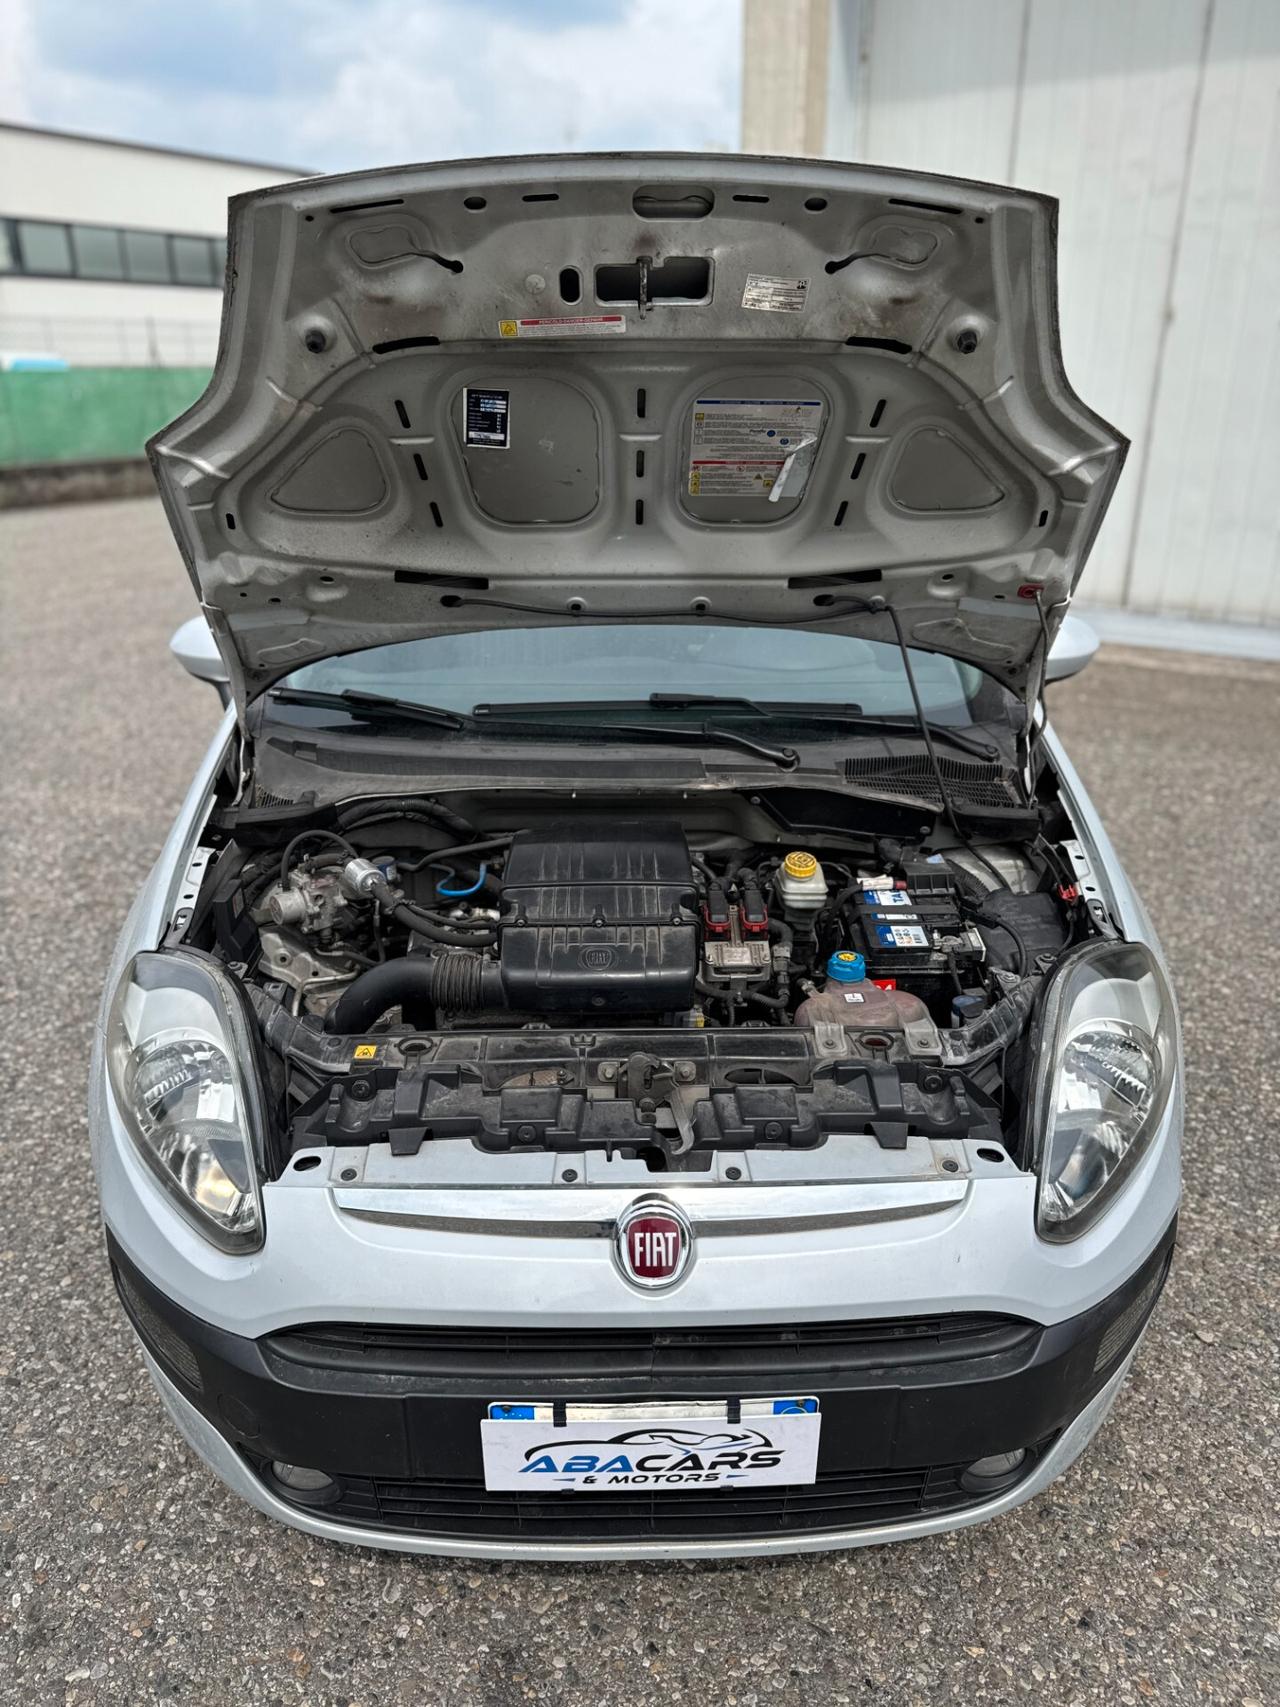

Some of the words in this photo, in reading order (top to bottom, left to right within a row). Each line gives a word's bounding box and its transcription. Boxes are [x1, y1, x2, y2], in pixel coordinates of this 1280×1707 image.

[633, 1231, 677, 1267] FIAT
[518, 1450, 786, 1473] ABACARS
[582, 1474, 598, 1485] &
[608, 1473, 720, 1485] MOTORS
